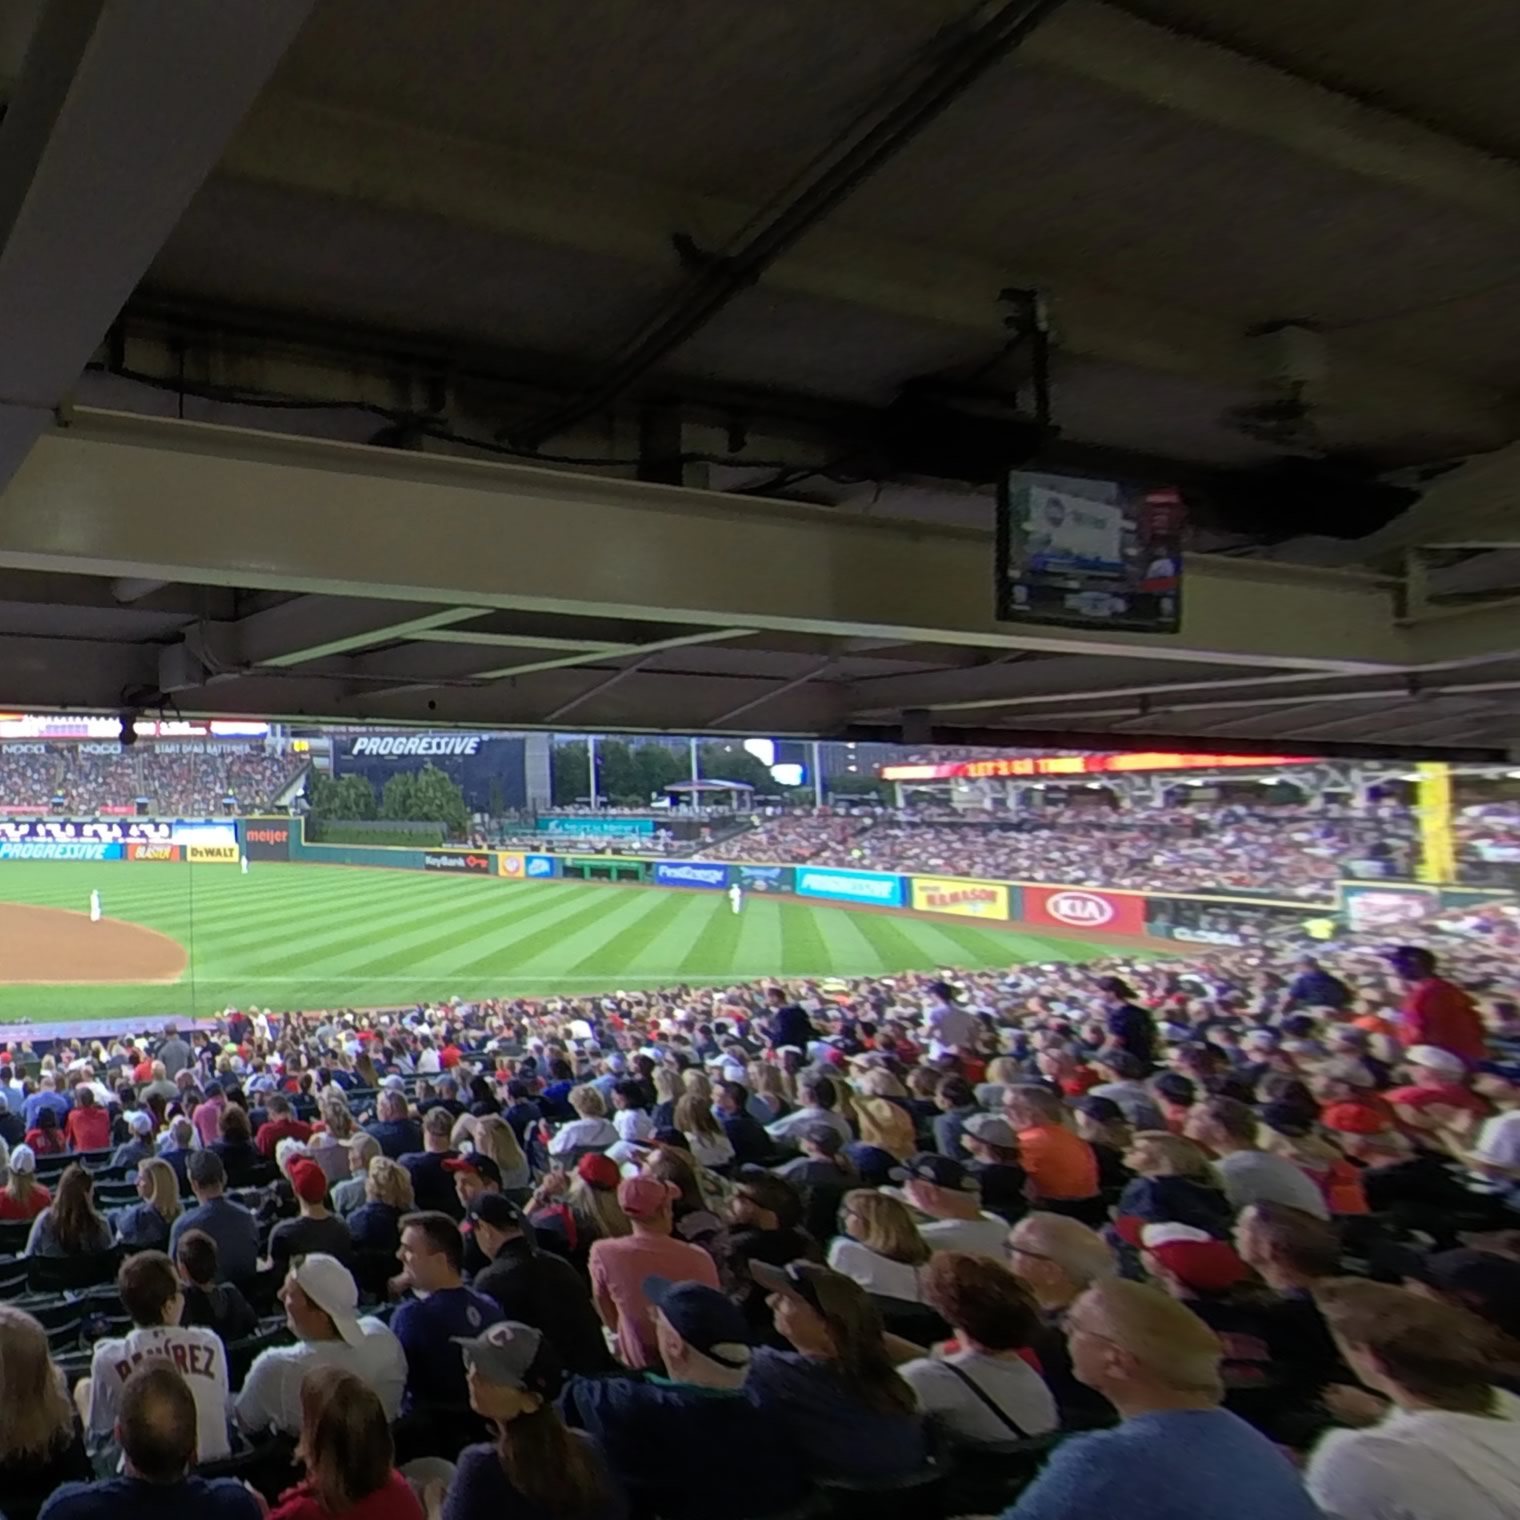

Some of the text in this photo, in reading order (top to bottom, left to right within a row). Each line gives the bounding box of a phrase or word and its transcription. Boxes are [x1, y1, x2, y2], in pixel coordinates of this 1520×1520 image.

[2, 743, 46, 754] NOCO
[78, 743, 122, 754] NOCO
[352, 737, 481, 756] PROGRESSIVE
[246, 829, 288, 846] meijer
[425, 855, 465, 867] KeyBank
[1058, 898, 1102, 921] KIA
